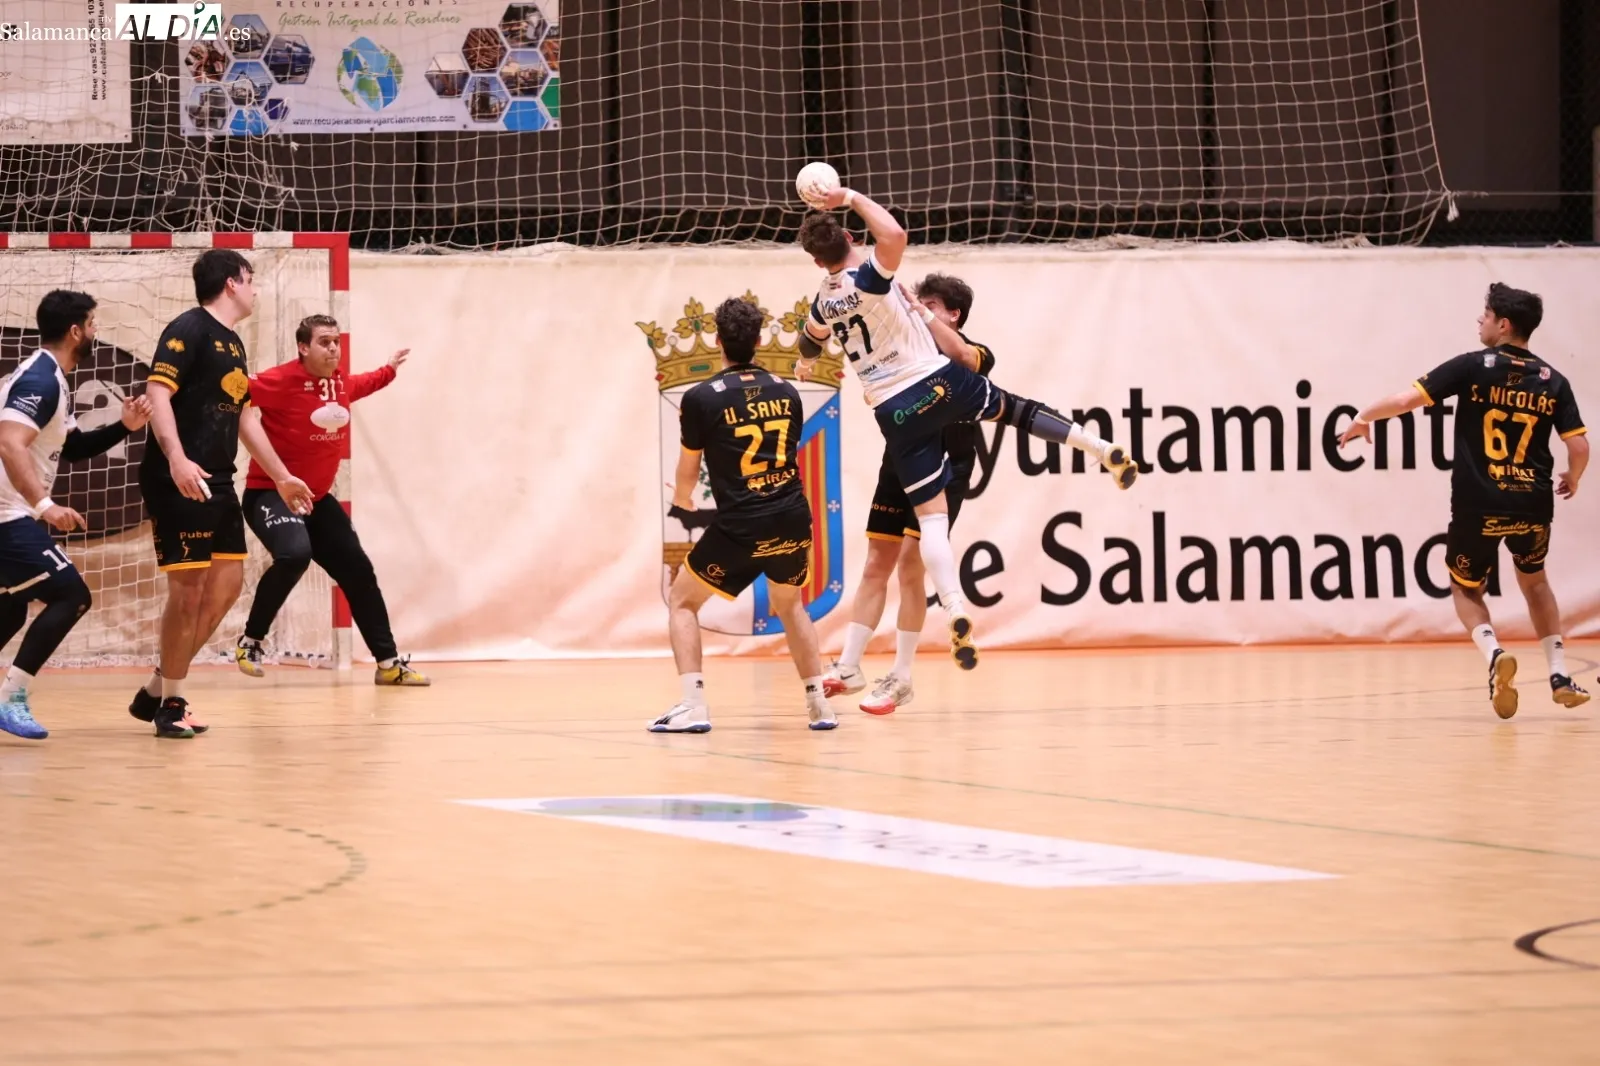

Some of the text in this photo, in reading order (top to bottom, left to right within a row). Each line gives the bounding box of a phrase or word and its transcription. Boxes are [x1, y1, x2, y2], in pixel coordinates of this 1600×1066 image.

[327, 11, 380, 32] Integral
[383, 13, 398, 26] de
[318, 378, 337, 401] 31
[747, 398, 792, 420] SANZ
[1471, 384, 1556, 416] S. NICOLÁS
[734, 419, 791, 477] 27
[964, 378, 1454, 500] yuntamient
[1483, 408, 1539, 464] 67
[1041, 511, 1503, 606] Salamanc
